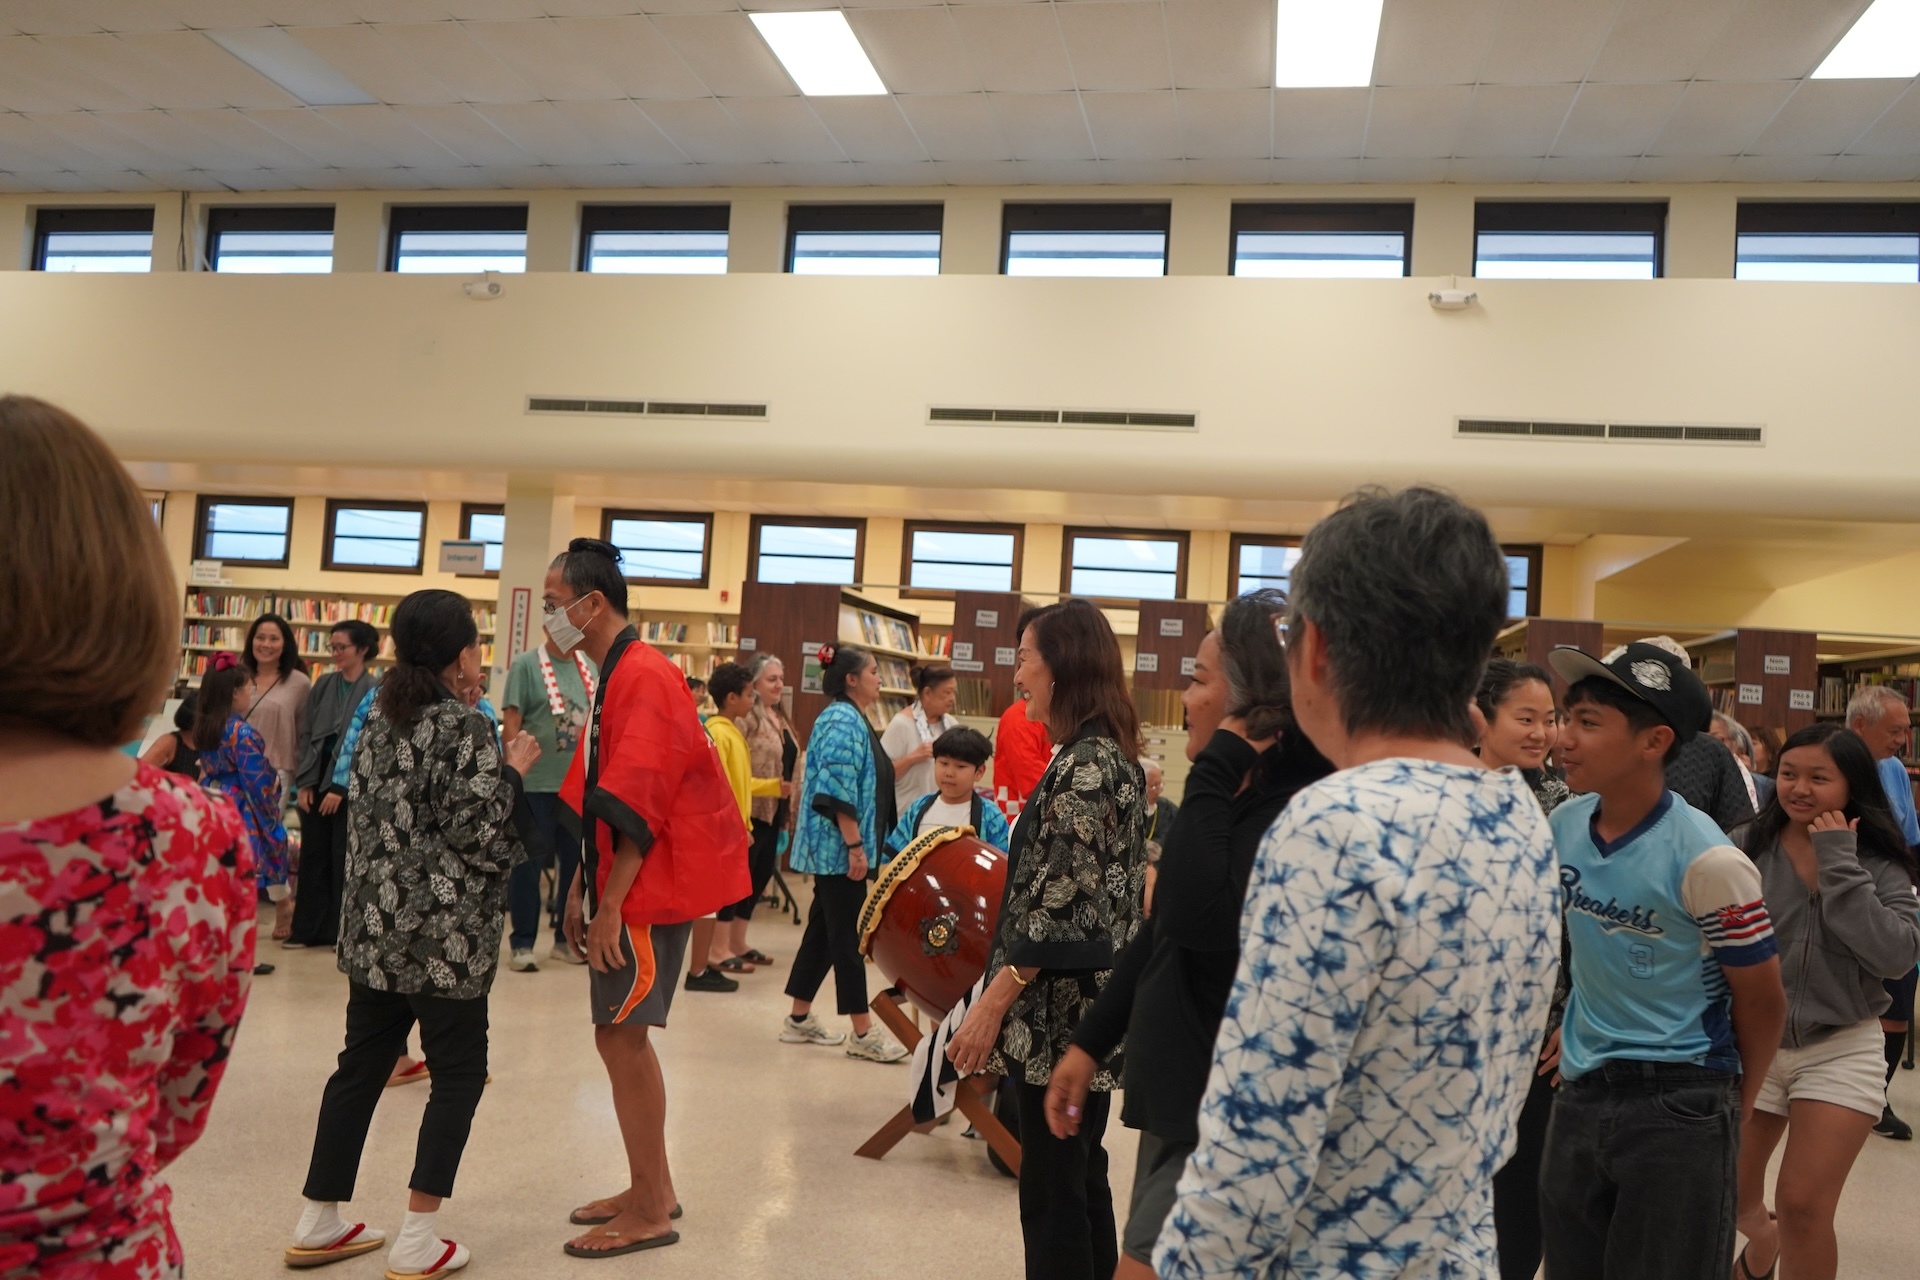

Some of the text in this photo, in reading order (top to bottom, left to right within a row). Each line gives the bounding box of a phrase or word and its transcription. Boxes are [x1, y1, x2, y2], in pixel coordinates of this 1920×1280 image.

[514, 594, 524, 655] INTERNE
[1559, 864, 1660, 933] Breakers
[1628, 942, 1655, 980] 3
